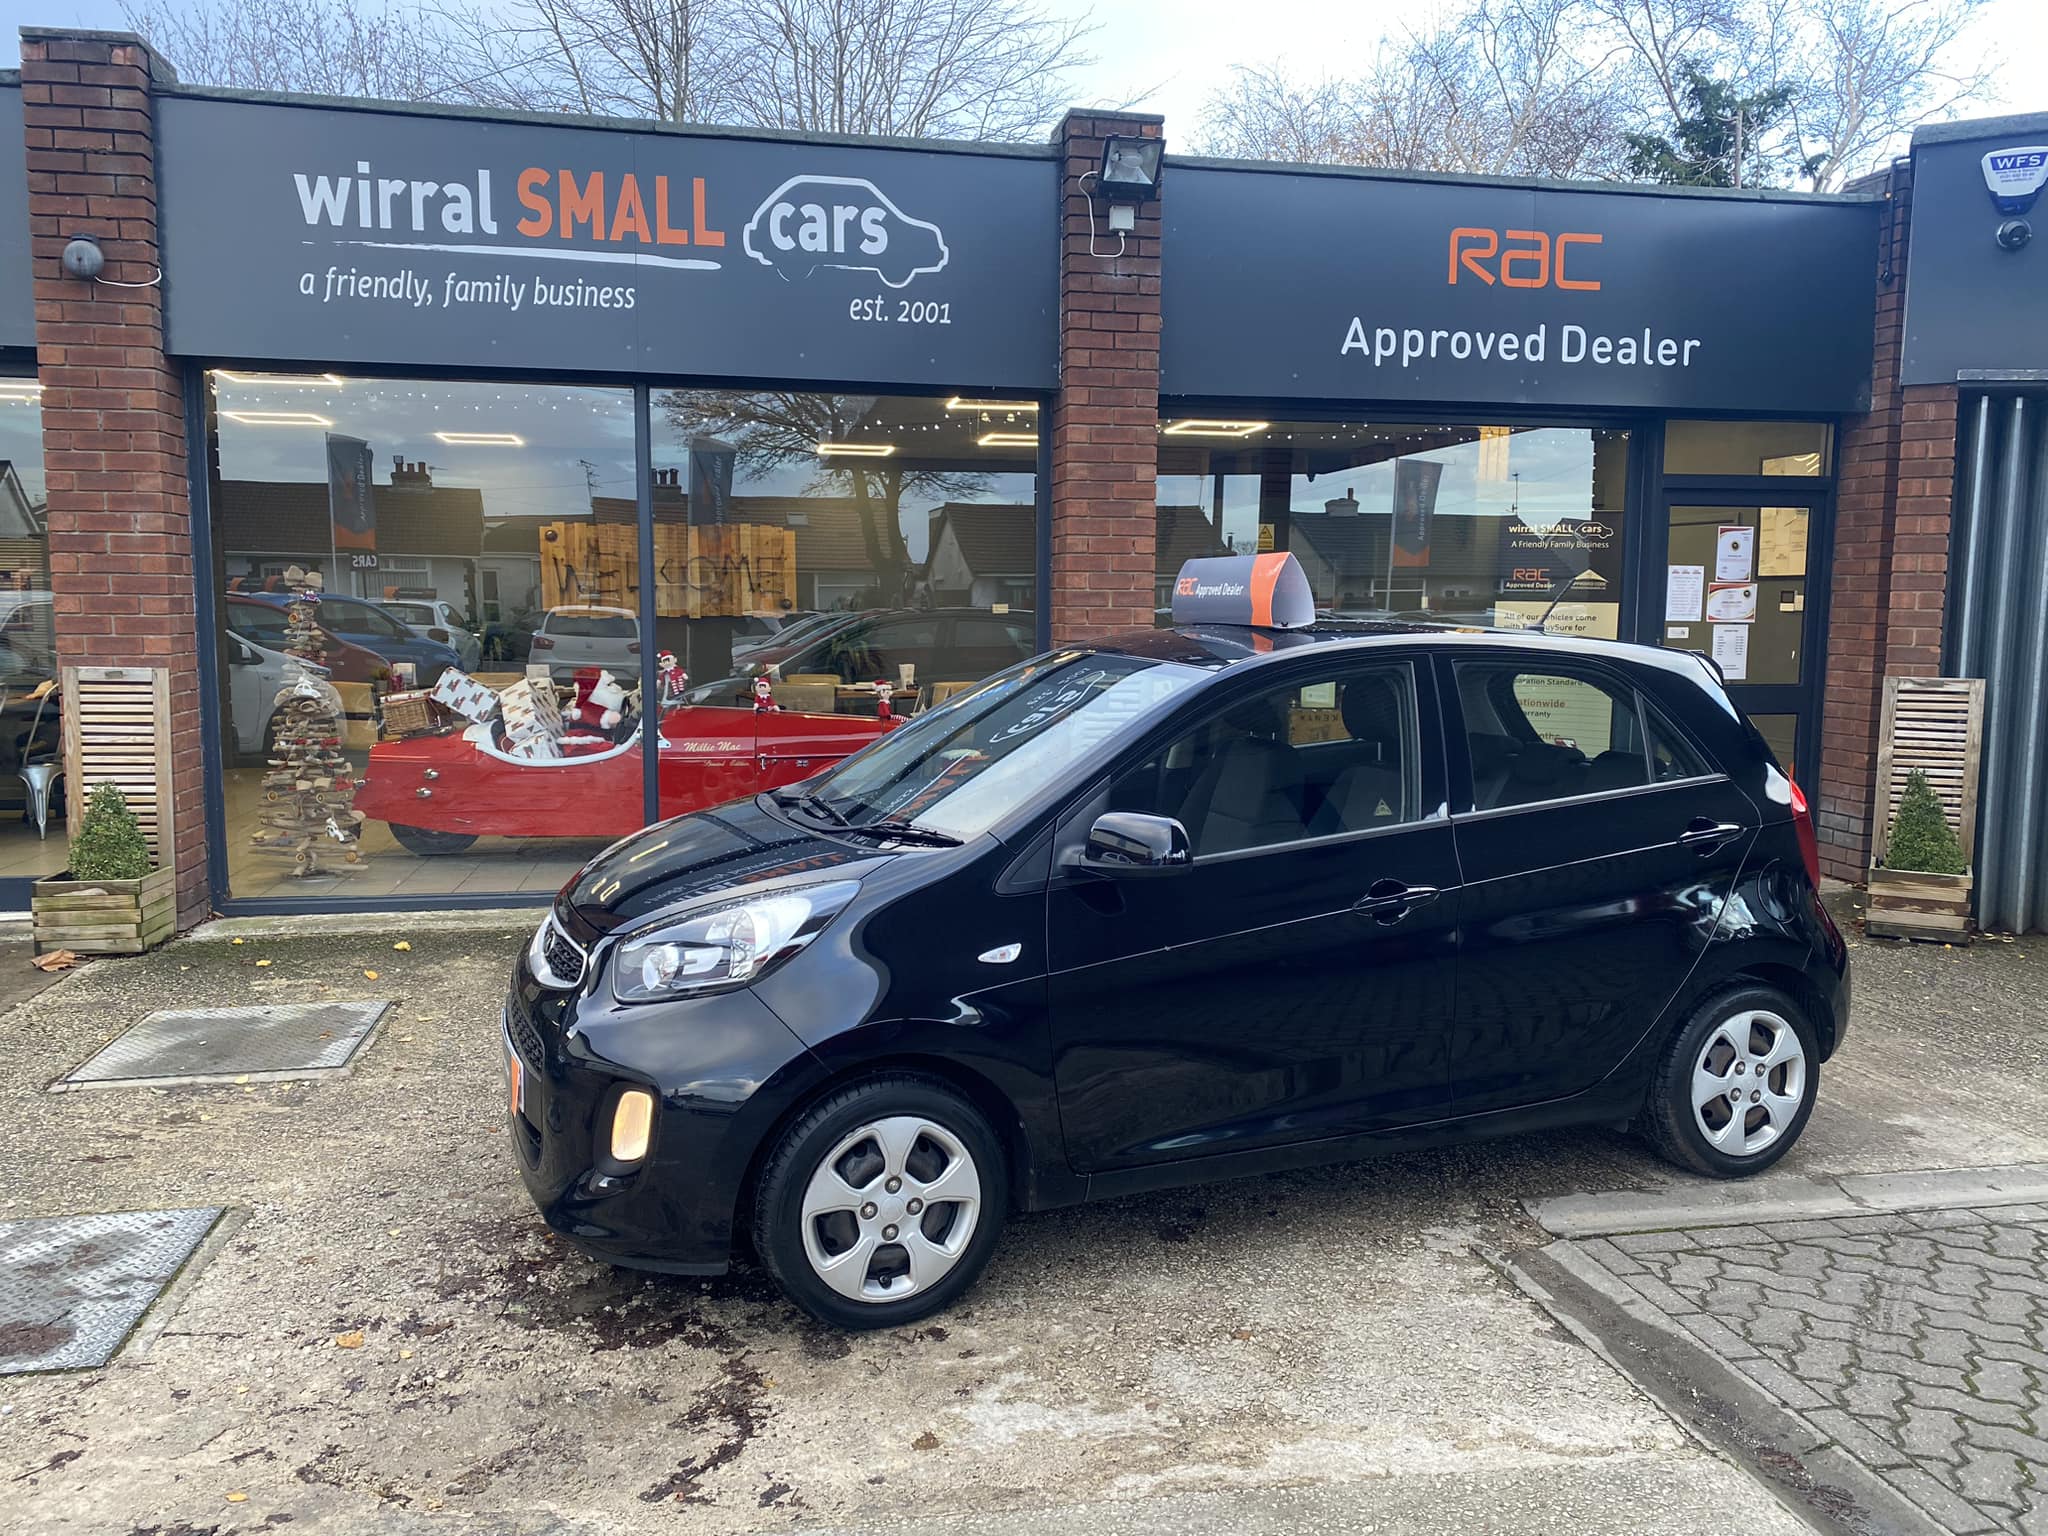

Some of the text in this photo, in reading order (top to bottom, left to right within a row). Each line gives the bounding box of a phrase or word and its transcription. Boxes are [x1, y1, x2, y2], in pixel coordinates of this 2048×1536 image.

[1996, 154, 2041, 169] WFS
[293, 160, 889, 256] wirral SMALL cars
[299, 265, 636, 313] a friendly, family business
[848, 293, 953, 326] est. 2001
[1340, 314, 1702, 368] Approved Dealer
[1508, 523, 1603, 533] wirral SMALL cars
[1511, 540, 1610, 550] A Friendly Family Business
[1195, 583, 1222, 599] Approved
[1222, 582, 1244, 597] Dealer
[1505, 582, 1535, 590] Approved
[1545, 624, 1573, 632] uySure
[1575, 624, 1587, 632] for
[683, 741, 741, 752] Millie Mac
